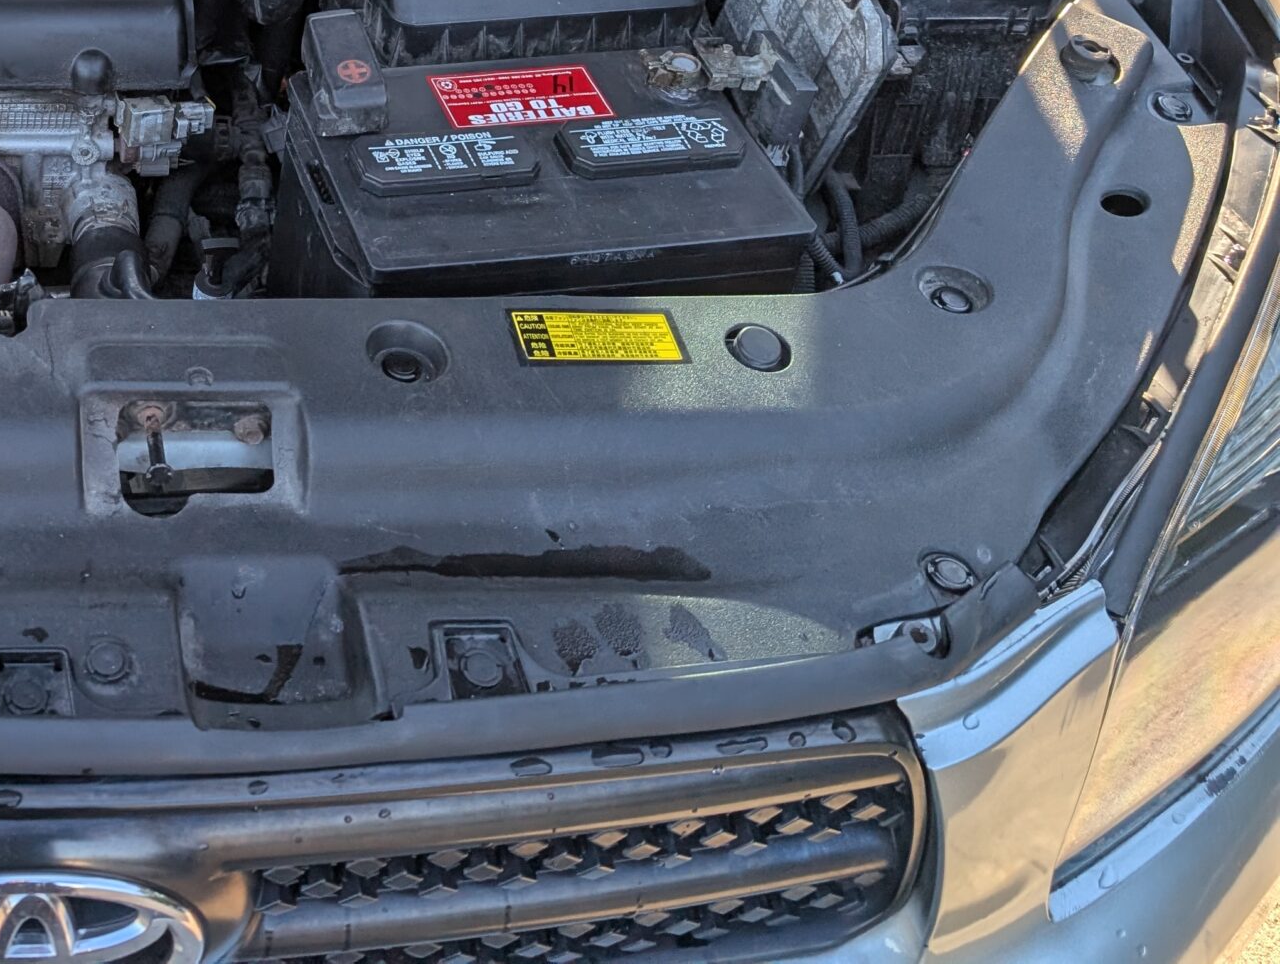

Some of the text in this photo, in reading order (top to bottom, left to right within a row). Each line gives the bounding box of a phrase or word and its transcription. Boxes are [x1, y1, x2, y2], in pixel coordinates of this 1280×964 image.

[490, 102, 524, 113] GO
[530, 99, 563, 110] TO
[468, 105, 595, 125] BATTERIES
[395, 136, 440, 146] DANGER
[451, 131, 492, 141] POISON
